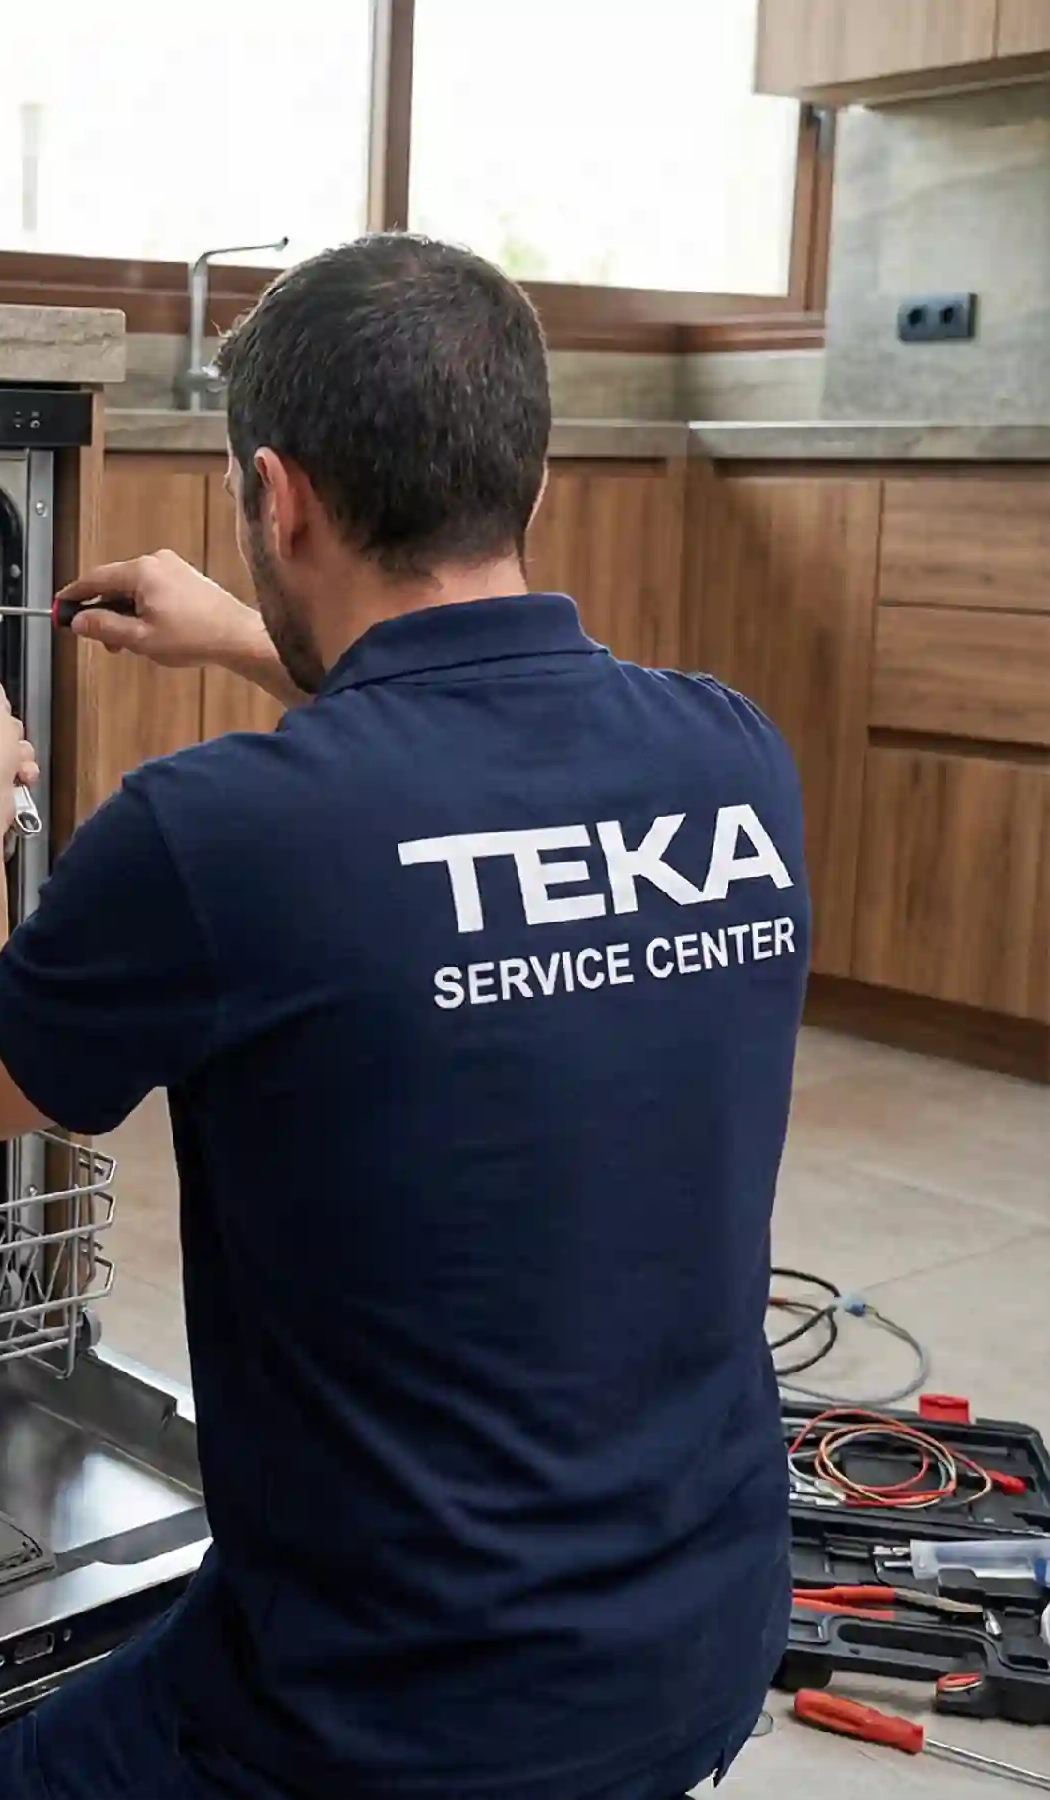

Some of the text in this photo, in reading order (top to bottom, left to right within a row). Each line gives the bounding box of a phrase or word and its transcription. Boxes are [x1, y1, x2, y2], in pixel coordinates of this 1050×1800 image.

[397, 803, 794, 933] TEKA
[433, 916, 797, 1010] SERVICE CENTER
